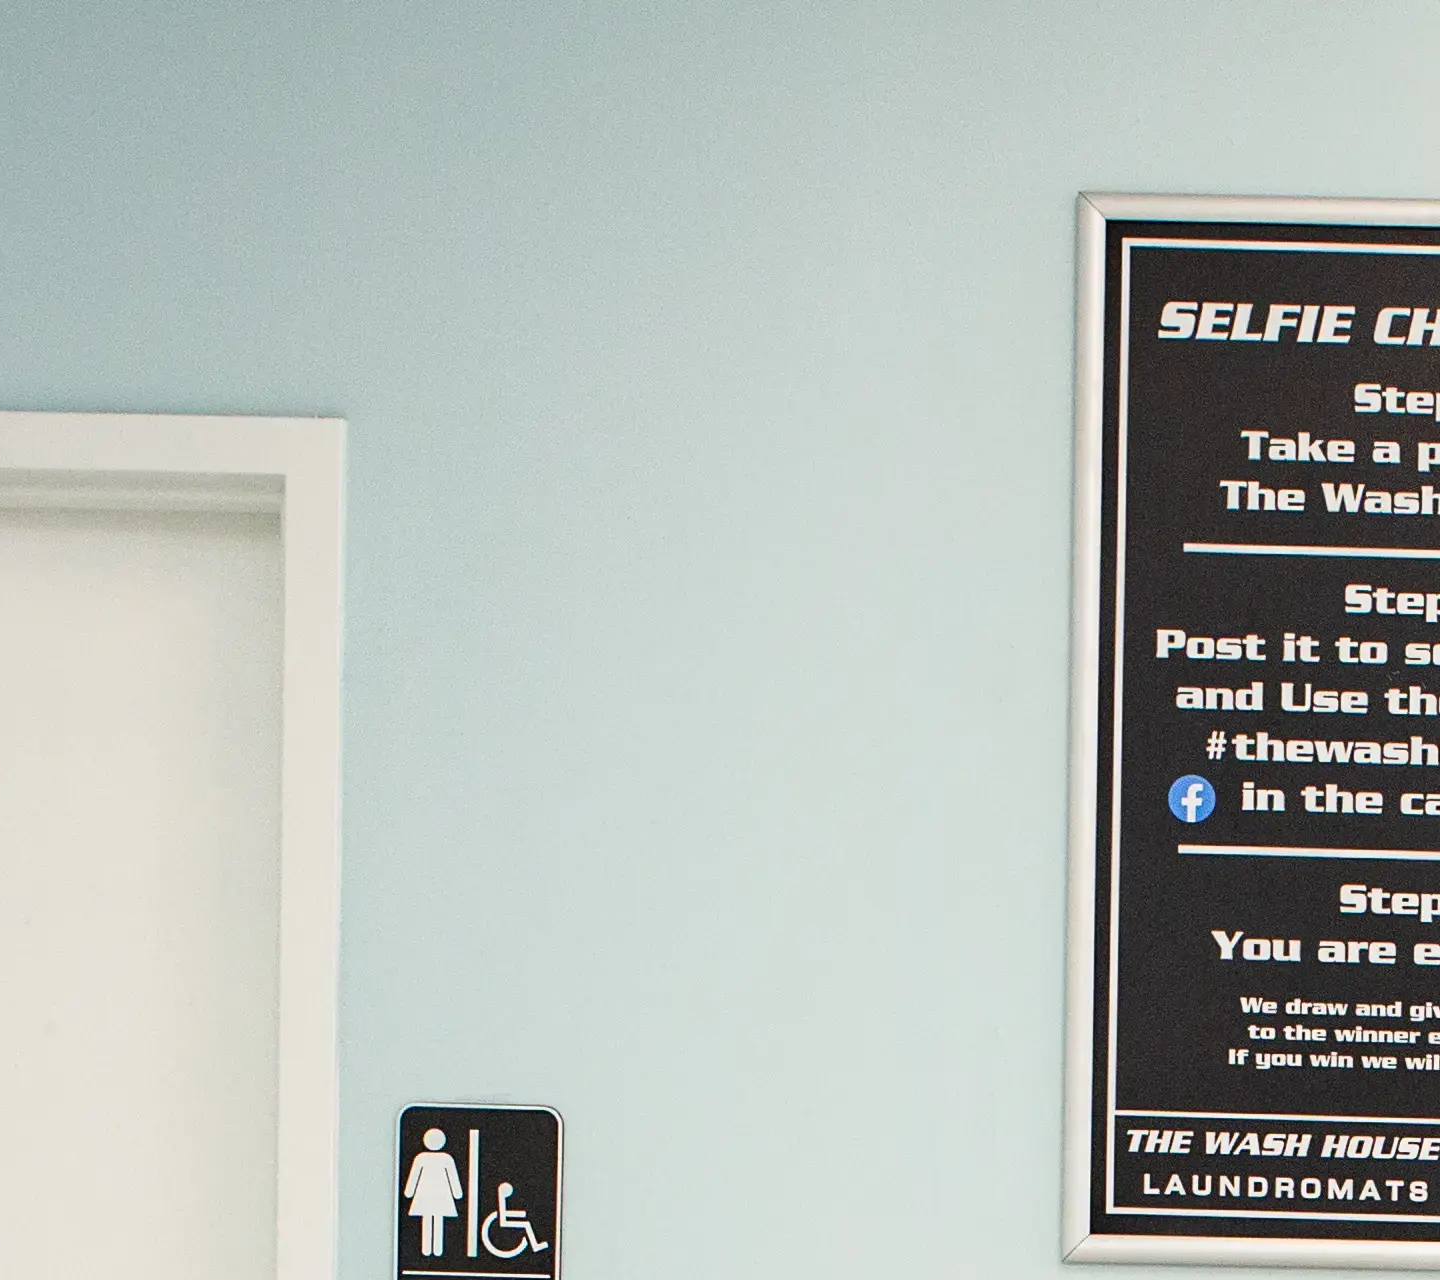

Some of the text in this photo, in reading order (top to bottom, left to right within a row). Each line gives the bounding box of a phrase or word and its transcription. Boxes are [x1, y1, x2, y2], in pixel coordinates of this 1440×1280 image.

[1158, 302, 1355, 343] SELFIE
[1241, 431, 1355, 462] Take
[1373, 441, 1400, 463] a
[1220, 480, 1305, 511] The
[1156, 629, 1266, 660] Post
[1283, 633, 1320, 662] it
[1335, 637, 1387, 663] to
[1176, 682, 1263, 710] and
[1281, 683, 1368, 713] Use
[1242, 782, 1285, 811] in
[1301, 784, 1383, 814] the
[1211, 931, 1301, 961] You
[1318, 941, 1396, 964] are
[1240, 997, 1277, 1013] We
[1286, 999, 1348, 1015] draw
[1356, 1002, 1402, 1017] and
[1248, 1025, 1275, 1039] to
[1283, 1025, 1326, 1041] the
[1334, 1026, 1421, 1043] winner
[1229, 1049, 1249, 1065] If
[1256, 1053, 1302, 1069] you
[1310, 1052, 1353, 1068] win
[1361, 1056, 1397, 1069] we
[1127, 1130, 1194, 1153] THE
[1206, 1132, 1312, 1156] WASH
[1144, 1174, 1428, 1202] LAUNDROMATS
